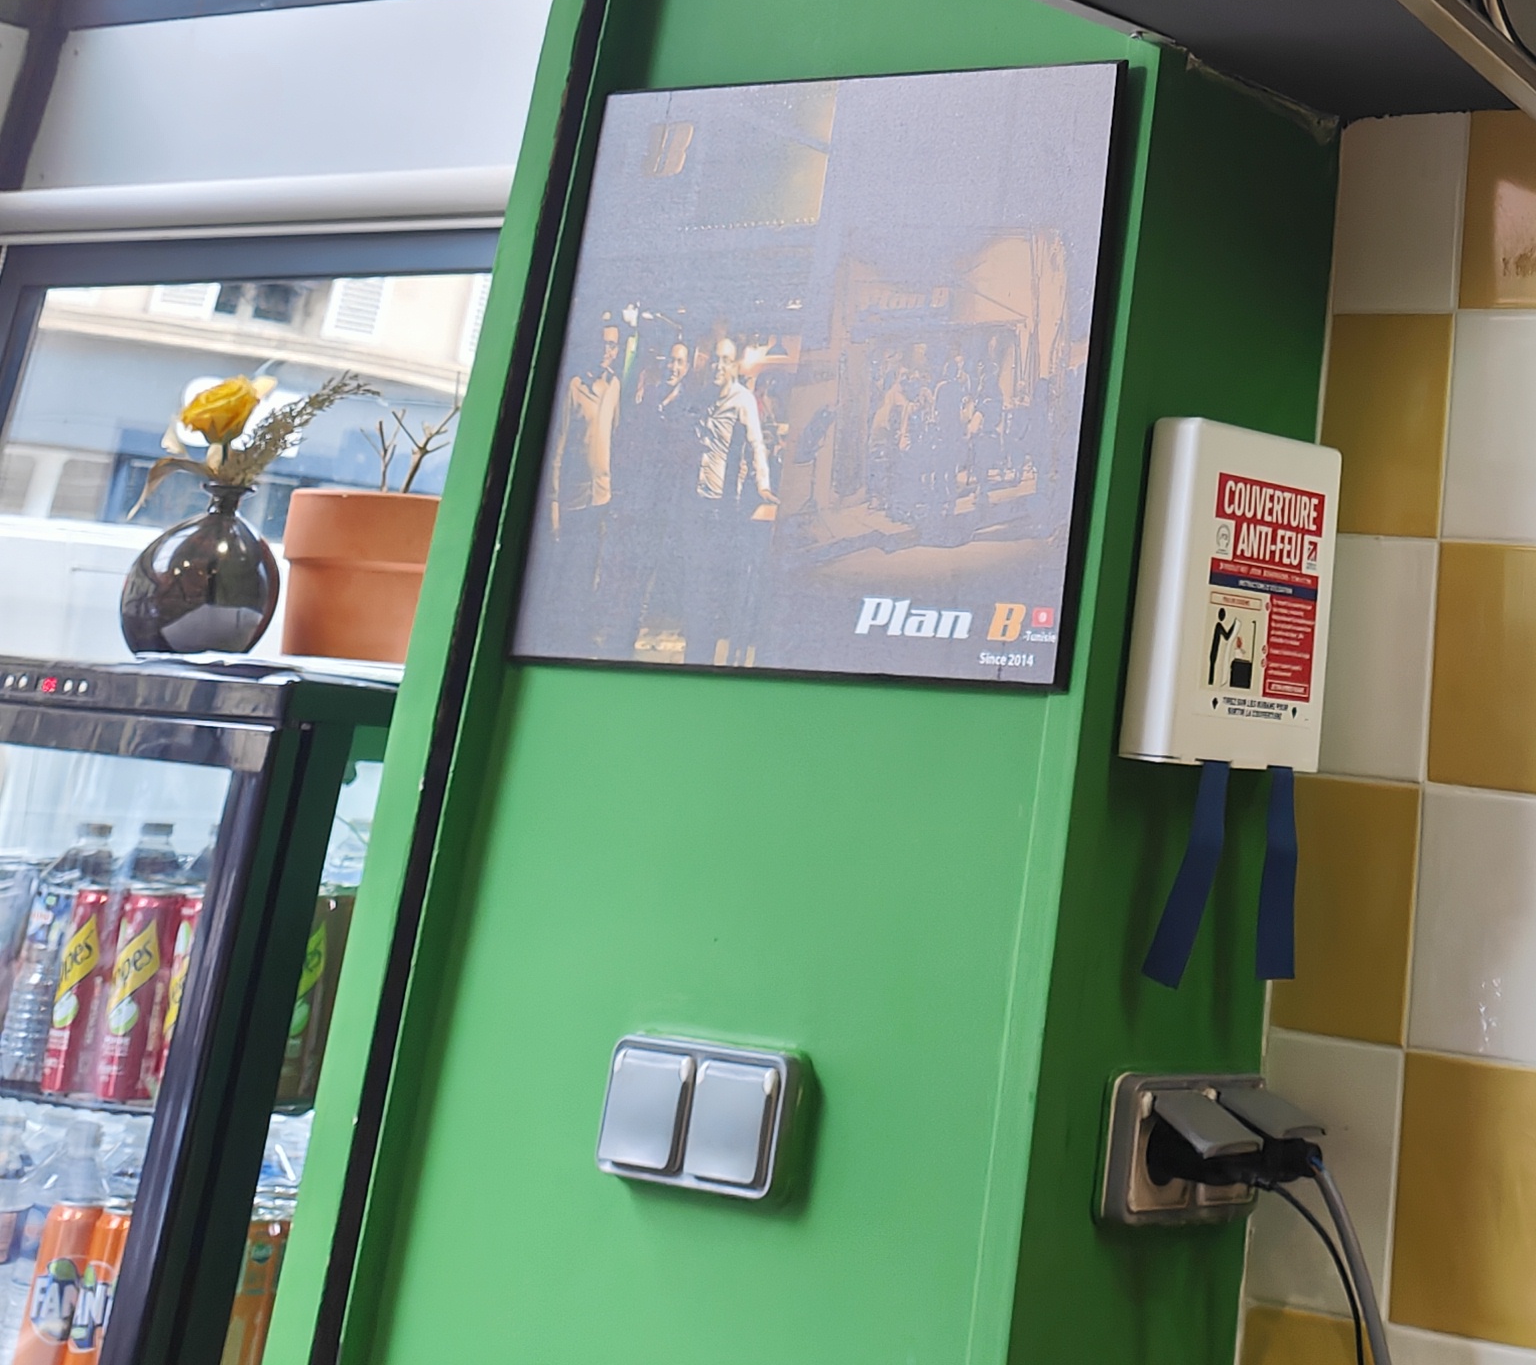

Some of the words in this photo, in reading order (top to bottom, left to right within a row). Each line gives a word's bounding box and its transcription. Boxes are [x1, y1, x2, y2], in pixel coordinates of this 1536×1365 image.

[1224, 480, 1319, 531] COUVERTURE
[1236, 522, 1302, 566] ANTI-FEU
[855, 597, 972, 639] Plan
[987, 603, 1026, 642] B
[979, 652, 1006, 665] Since
[1008, 654, 1034, 667] 2014
